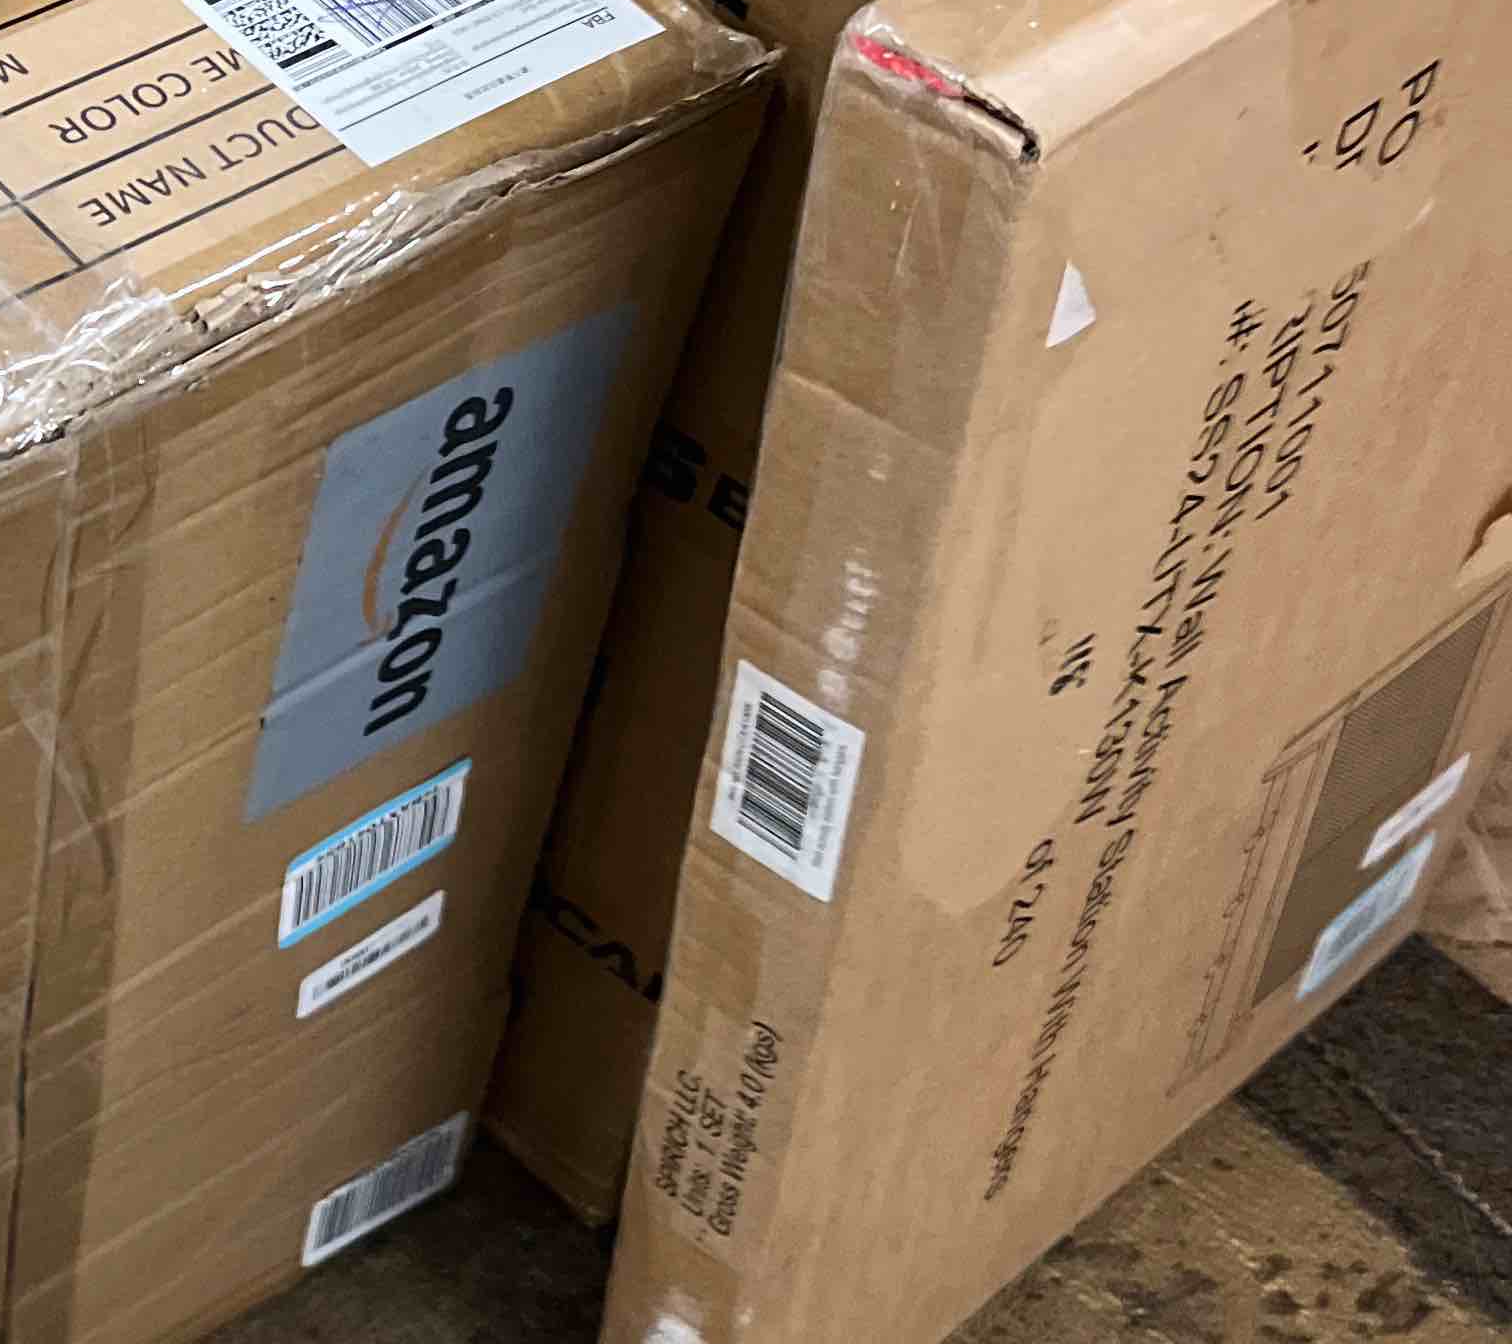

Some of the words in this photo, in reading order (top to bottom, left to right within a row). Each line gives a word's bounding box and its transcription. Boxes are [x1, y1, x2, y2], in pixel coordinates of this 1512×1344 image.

[578, 9, 618, 30] FBA
[48, 72, 192, 144] COLOR
[77, 157, 207, 227] NAME
[361, 386, 514, 737] amazon
[1164, 548, 1234, 668] Wall
[1105, 674, 1188, 825] Activity
[991, 881, 1046, 968] 240
[1060, 828, 1135, 974] Station
